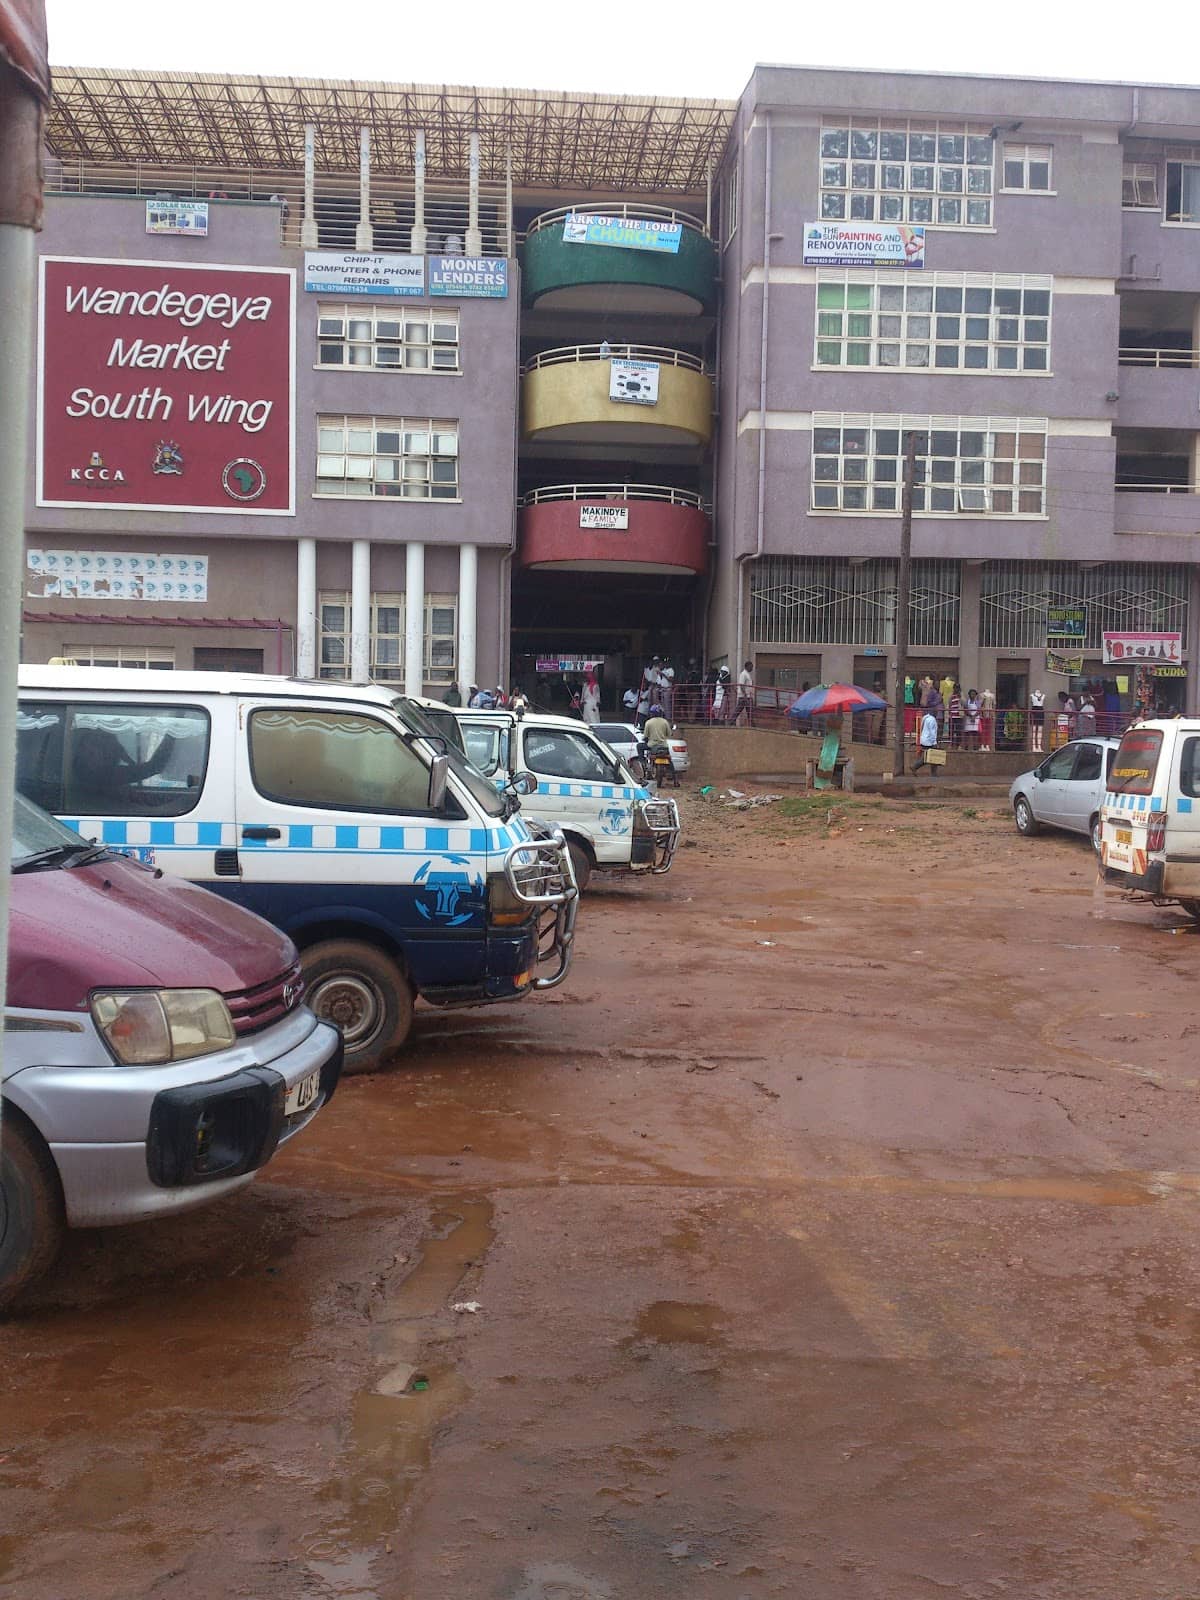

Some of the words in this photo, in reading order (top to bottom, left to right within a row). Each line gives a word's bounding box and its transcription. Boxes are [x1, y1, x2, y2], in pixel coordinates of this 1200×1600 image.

[567, 215, 594, 225] ARK
[596, 217, 614, 226] OF
[619, 219, 641, 229] THE
[646, 222, 678, 233] LORD
[590, 225, 658, 244] CHURCH
[839, 232, 882, 242] PAINTING
[883, 234, 901, 242] AND
[807, 240, 872, 251] RENOVATION
[344, 256, 384, 264] CHIP-IT
[441, 259, 497, 272] MONEY
[307, 264, 370, 274] COMPUTER
[383, 268, 422, 276] PHONE
[344, 277, 390, 286] REPAIRS
[433, 272, 504, 285] LENDERS
[65, 284, 272, 328] Wandegeya
[106, 336, 231, 371] Market
[66, 387, 173, 421] South
[187, 394, 273, 433] Wing
[71, 468, 124, 480] KCCA
[582, 507, 626, 516] MAKINDYE
